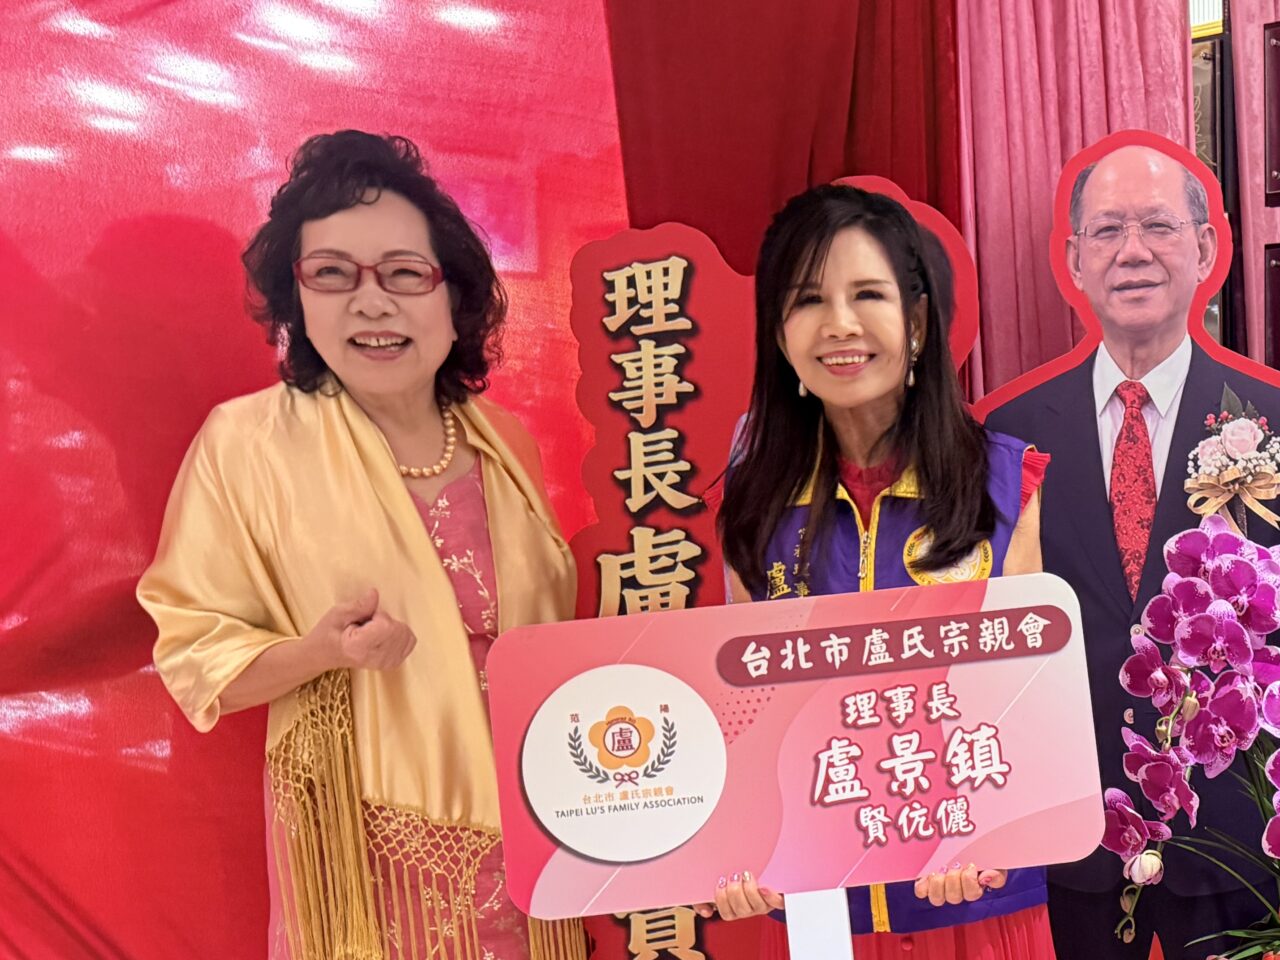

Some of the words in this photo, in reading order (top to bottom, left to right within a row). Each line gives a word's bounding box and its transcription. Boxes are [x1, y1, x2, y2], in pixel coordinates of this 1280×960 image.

[741, 612, 1052, 679] 台北市盧氏宗親會
[844, 682, 961, 728] 理事長
[611, 727, 635, 752] 盧
[813, 725, 1010, 804] 盧景鎮
[555, 806, 583, 819] TAIPEI
[586, 804, 605, 816] LU'S
[608, 802, 640, 814] FAMILY
[642, 796, 704, 810] ASSOCIATION
[582, 791, 614, 805] 台北市
[619, 785, 675, 801] 盧氏宗親會
[858, 800, 976, 847] 賢伉儷
